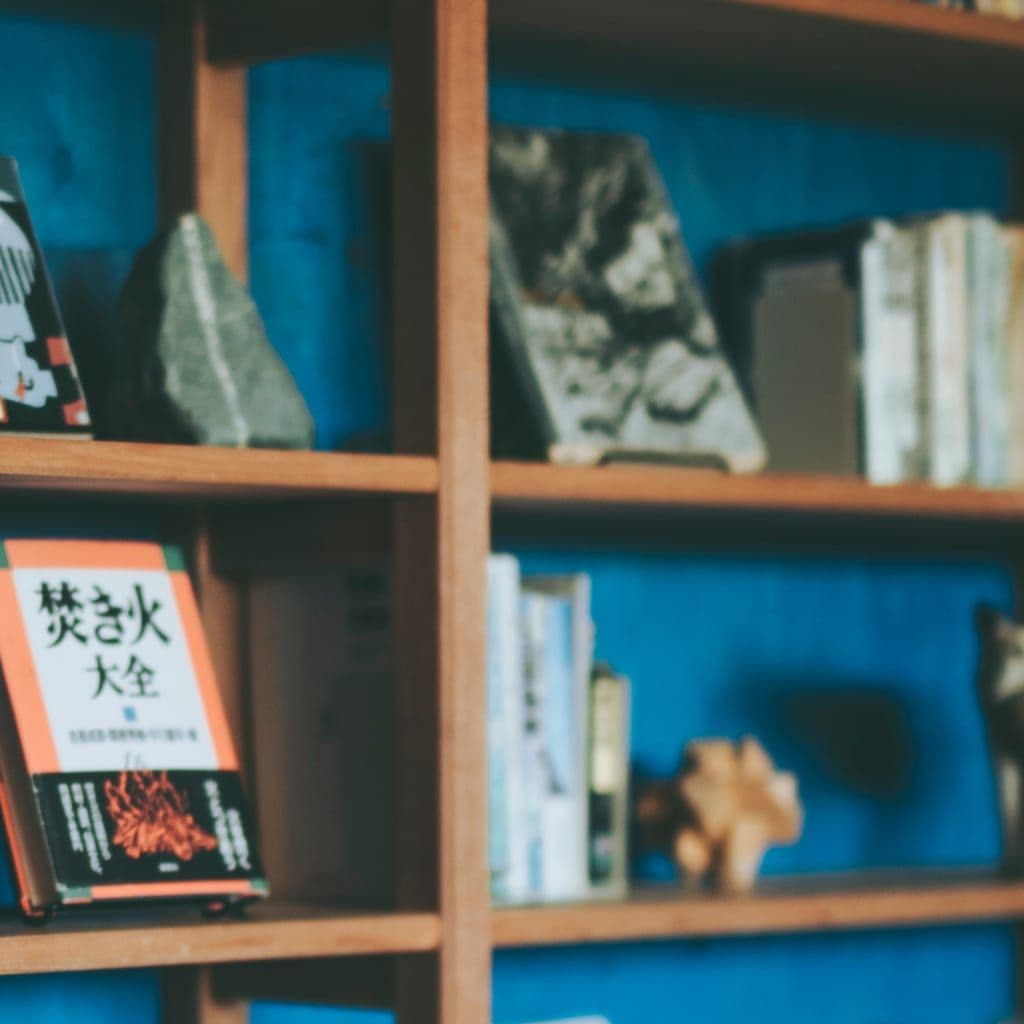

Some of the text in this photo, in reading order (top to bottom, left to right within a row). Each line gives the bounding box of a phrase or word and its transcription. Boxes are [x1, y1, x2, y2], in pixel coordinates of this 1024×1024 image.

[35, 580, 171, 648] 焚き火
[86, 654, 159, 699] 大全
